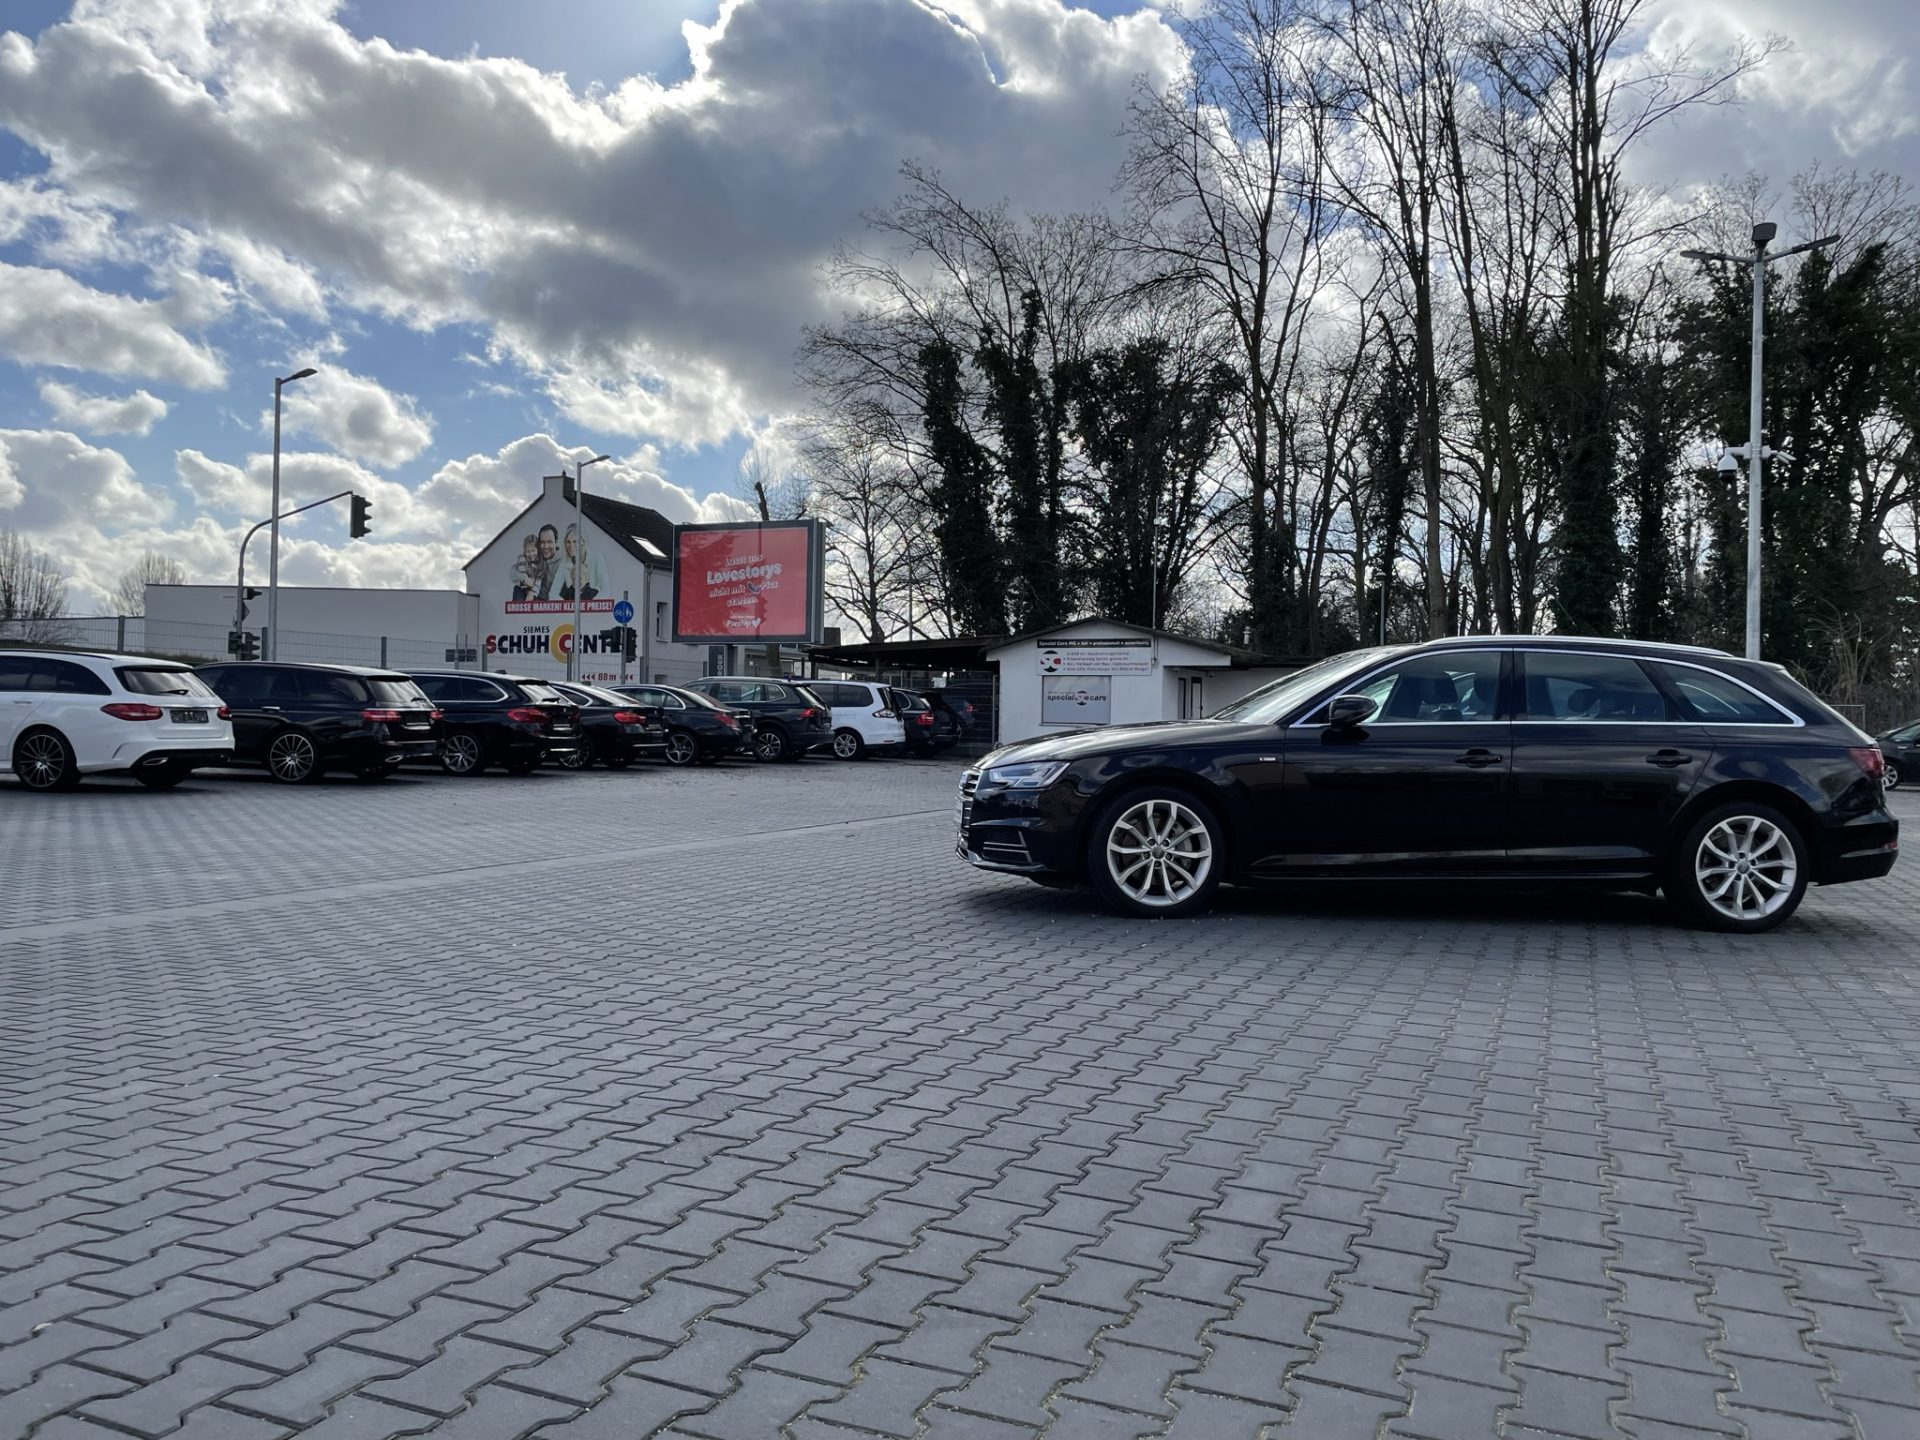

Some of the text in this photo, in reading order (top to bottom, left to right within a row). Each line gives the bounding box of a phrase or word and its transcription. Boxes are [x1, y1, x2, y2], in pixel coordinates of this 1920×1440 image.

[707, 563, 782, 585] Lovestorys
[508, 603, 532, 612] GROSSE
[532, 602, 563, 611] MARKEN!
[587, 601, 613, 610] PREISE!
[724, 618, 752, 629] Parship
[523, 626, 550, 634] SIEMES
[1048, 694, 1076, 702] special
